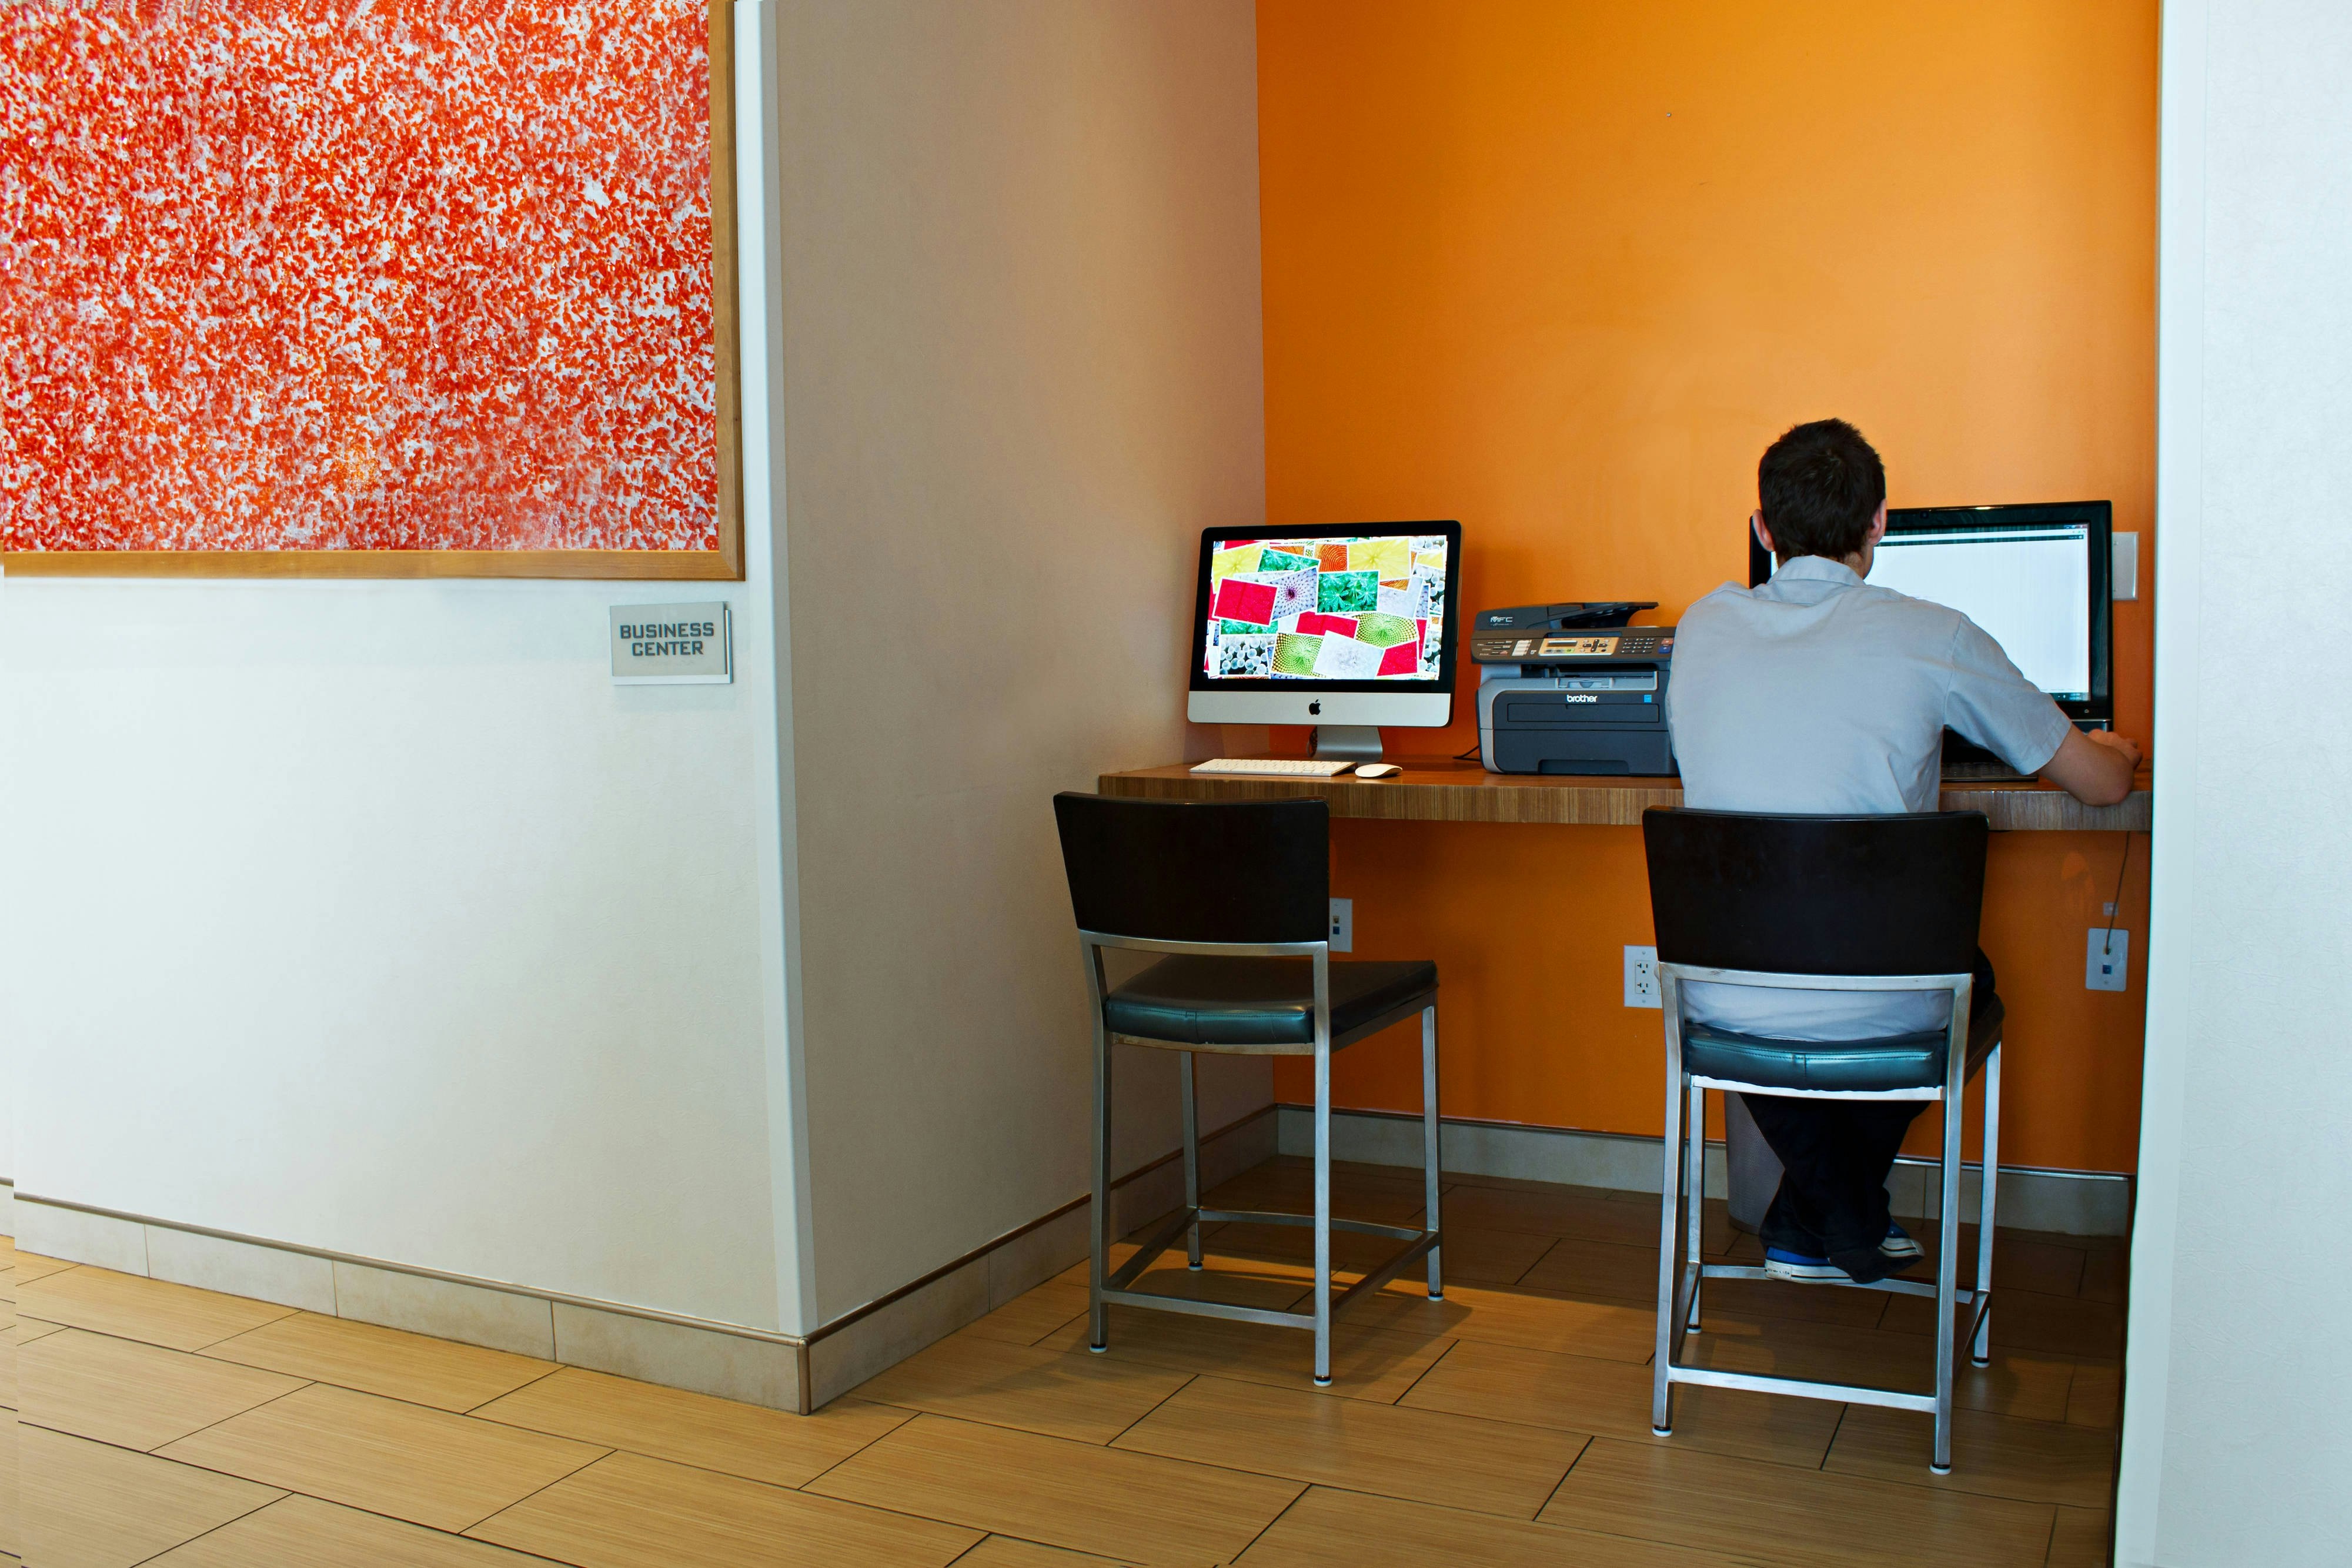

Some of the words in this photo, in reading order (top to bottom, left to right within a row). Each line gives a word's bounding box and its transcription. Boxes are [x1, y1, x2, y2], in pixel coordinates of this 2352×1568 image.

[620, 622, 714, 639] BUSINESS
[632, 640, 704, 656] CENTER
[1566, 694, 1598, 703] brother
